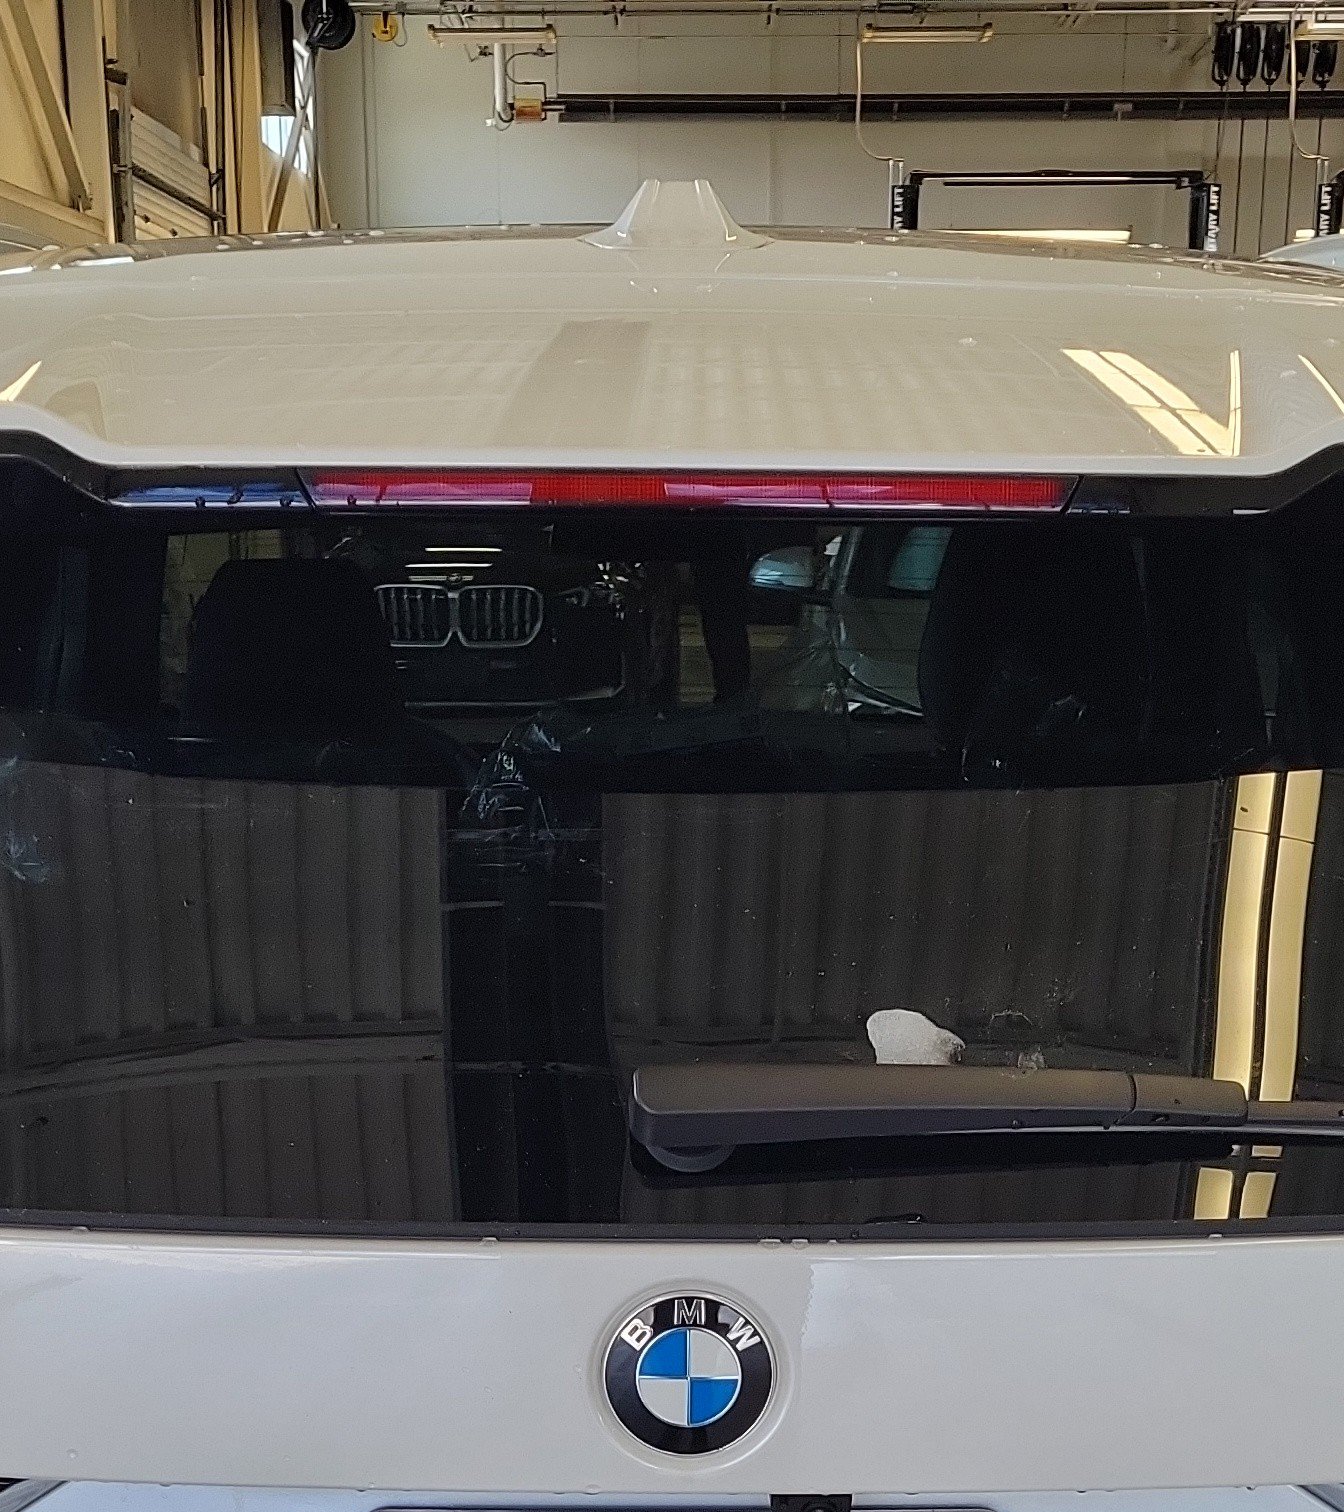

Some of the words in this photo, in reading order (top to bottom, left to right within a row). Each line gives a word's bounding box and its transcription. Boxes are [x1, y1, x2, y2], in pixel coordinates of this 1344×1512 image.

[894, 187, 904, 212] LIFT
[1209, 185, 1220, 210] LIFT
[1320, 185, 1332, 210] LIFT
[620, 1299, 762, 1351] BMW
